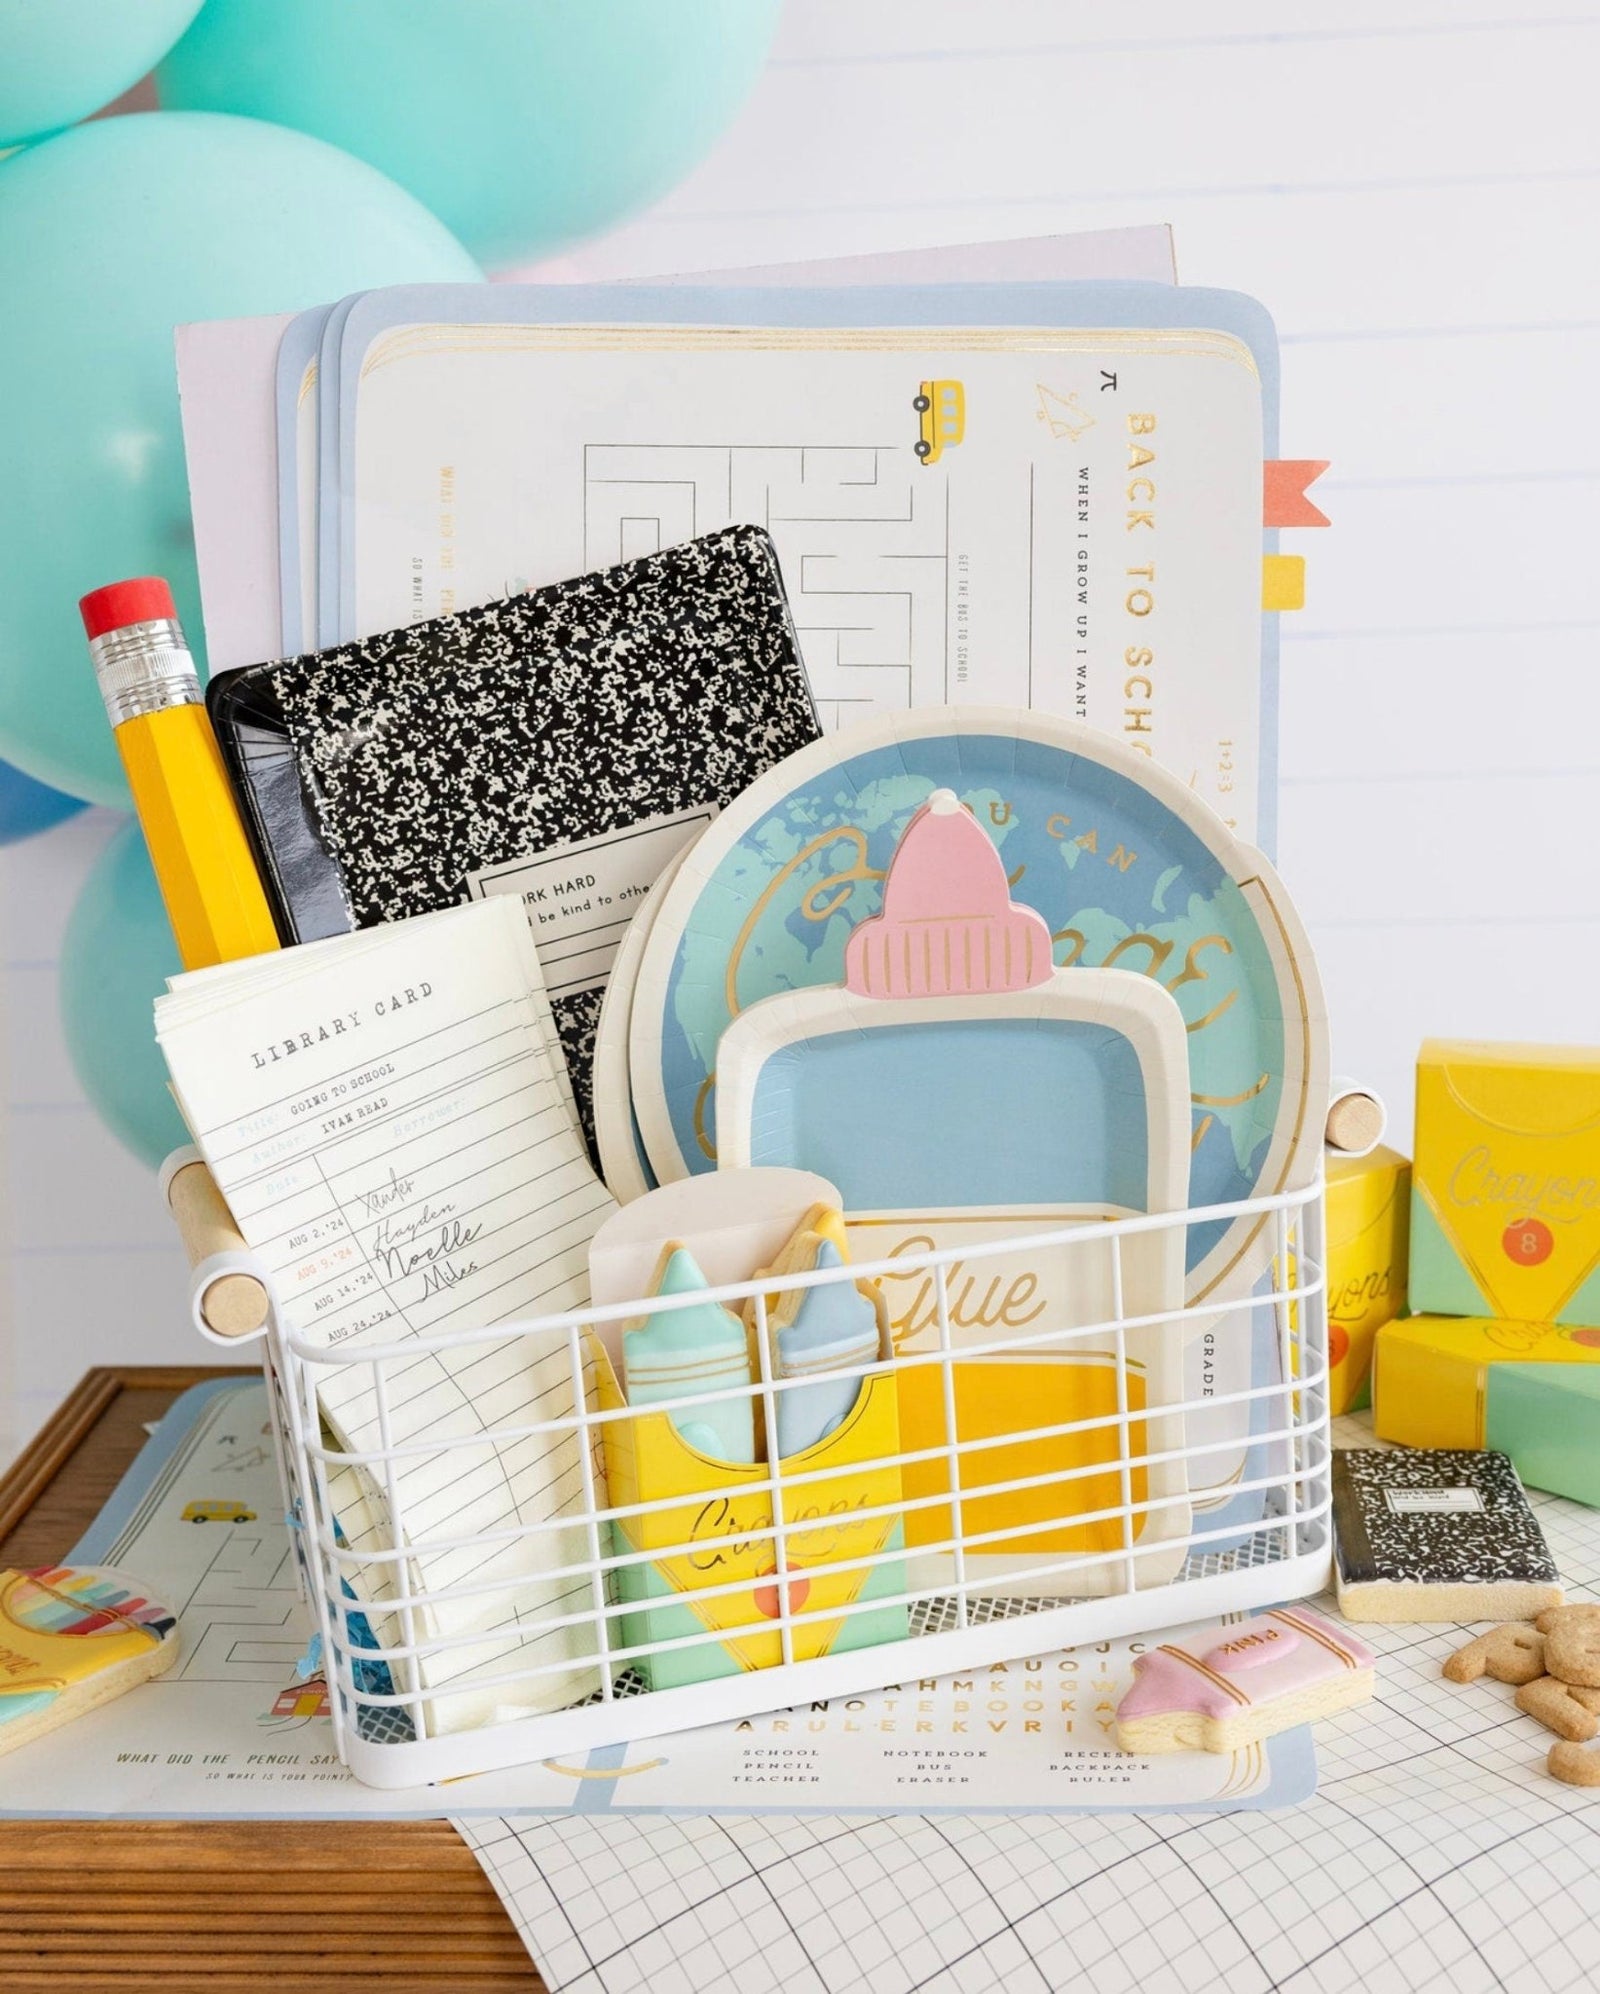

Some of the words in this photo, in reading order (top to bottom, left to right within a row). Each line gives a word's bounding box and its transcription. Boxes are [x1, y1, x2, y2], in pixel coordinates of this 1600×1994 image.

[1126, 413, 1156, 531] BACK
[1078, 466, 1089, 522] WHEN
[412, 557, 423, 570] SO
[958, 554, 968, 572] GET
[413, 576, 423, 602] WHAT
[958, 580, 968, 596] THE
[1077, 550, 1088, 604] GROW
[1126, 562, 1154, 617] TO
[957, 604, 968, 621] BUS
[958, 629, 968, 640] TO
[1077, 615, 1087, 638] UP
[957, 646, 968, 682] SCHOOL
[1076, 665, 1087, 717] WANT
[1218, 740, 1233, 793] 1+2=3
[1046, 813, 1138, 873] CAN
[552, 874, 596, 897] HARD
[538, 912, 556, 924] be
[562, 900, 592, 917] kind
[599, 897, 612, 906] to
[251, 1011, 361, 1069] LIBRARY
[375, 982, 433, 1016] CARD
[290, 1092, 328, 1115] GOING
[331, 1084, 347, 1097] TO
[350, 1063, 395, 1089] SCHOOL
[321, 1112, 354, 1134] IVAN
[356, 1097, 389, 1118] READ
[355, 1168, 415, 1218] Xander
[289, 1233, 308, 1249] AUG
[373, 1205, 455, 1258] Hayden
[1520, 1233, 1538, 1254] 8
[376, 1221, 482, 1278] Noelle
[296, 1264, 318, 1280] AUG
[417, 1261, 478, 1303] Miles
[314, 1295, 334, 1311] AUG
[874, 1235, 1048, 1351] Glue
[328, 1327, 348, 1342] AUG
[1203, 1333, 1214, 1396] GRADE
[116, 1753, 158, 1765] WHAT
[167, 1753, 193, 1765] DID
[202, 1753, 231, 1765] THE
[247, 1753, 301, 1765] PENCIL
[309, 1753, 339, 1765] SAY
[743, 1749, 820, 1757] SCHOOL
[883, 1749, 989, 1758] NOTEBOOK
[205, 1773, 220, 1781] SO
[281, 1773, 307, 1781] YOUR
[732, 1775, 821, 1783] TEACHER
